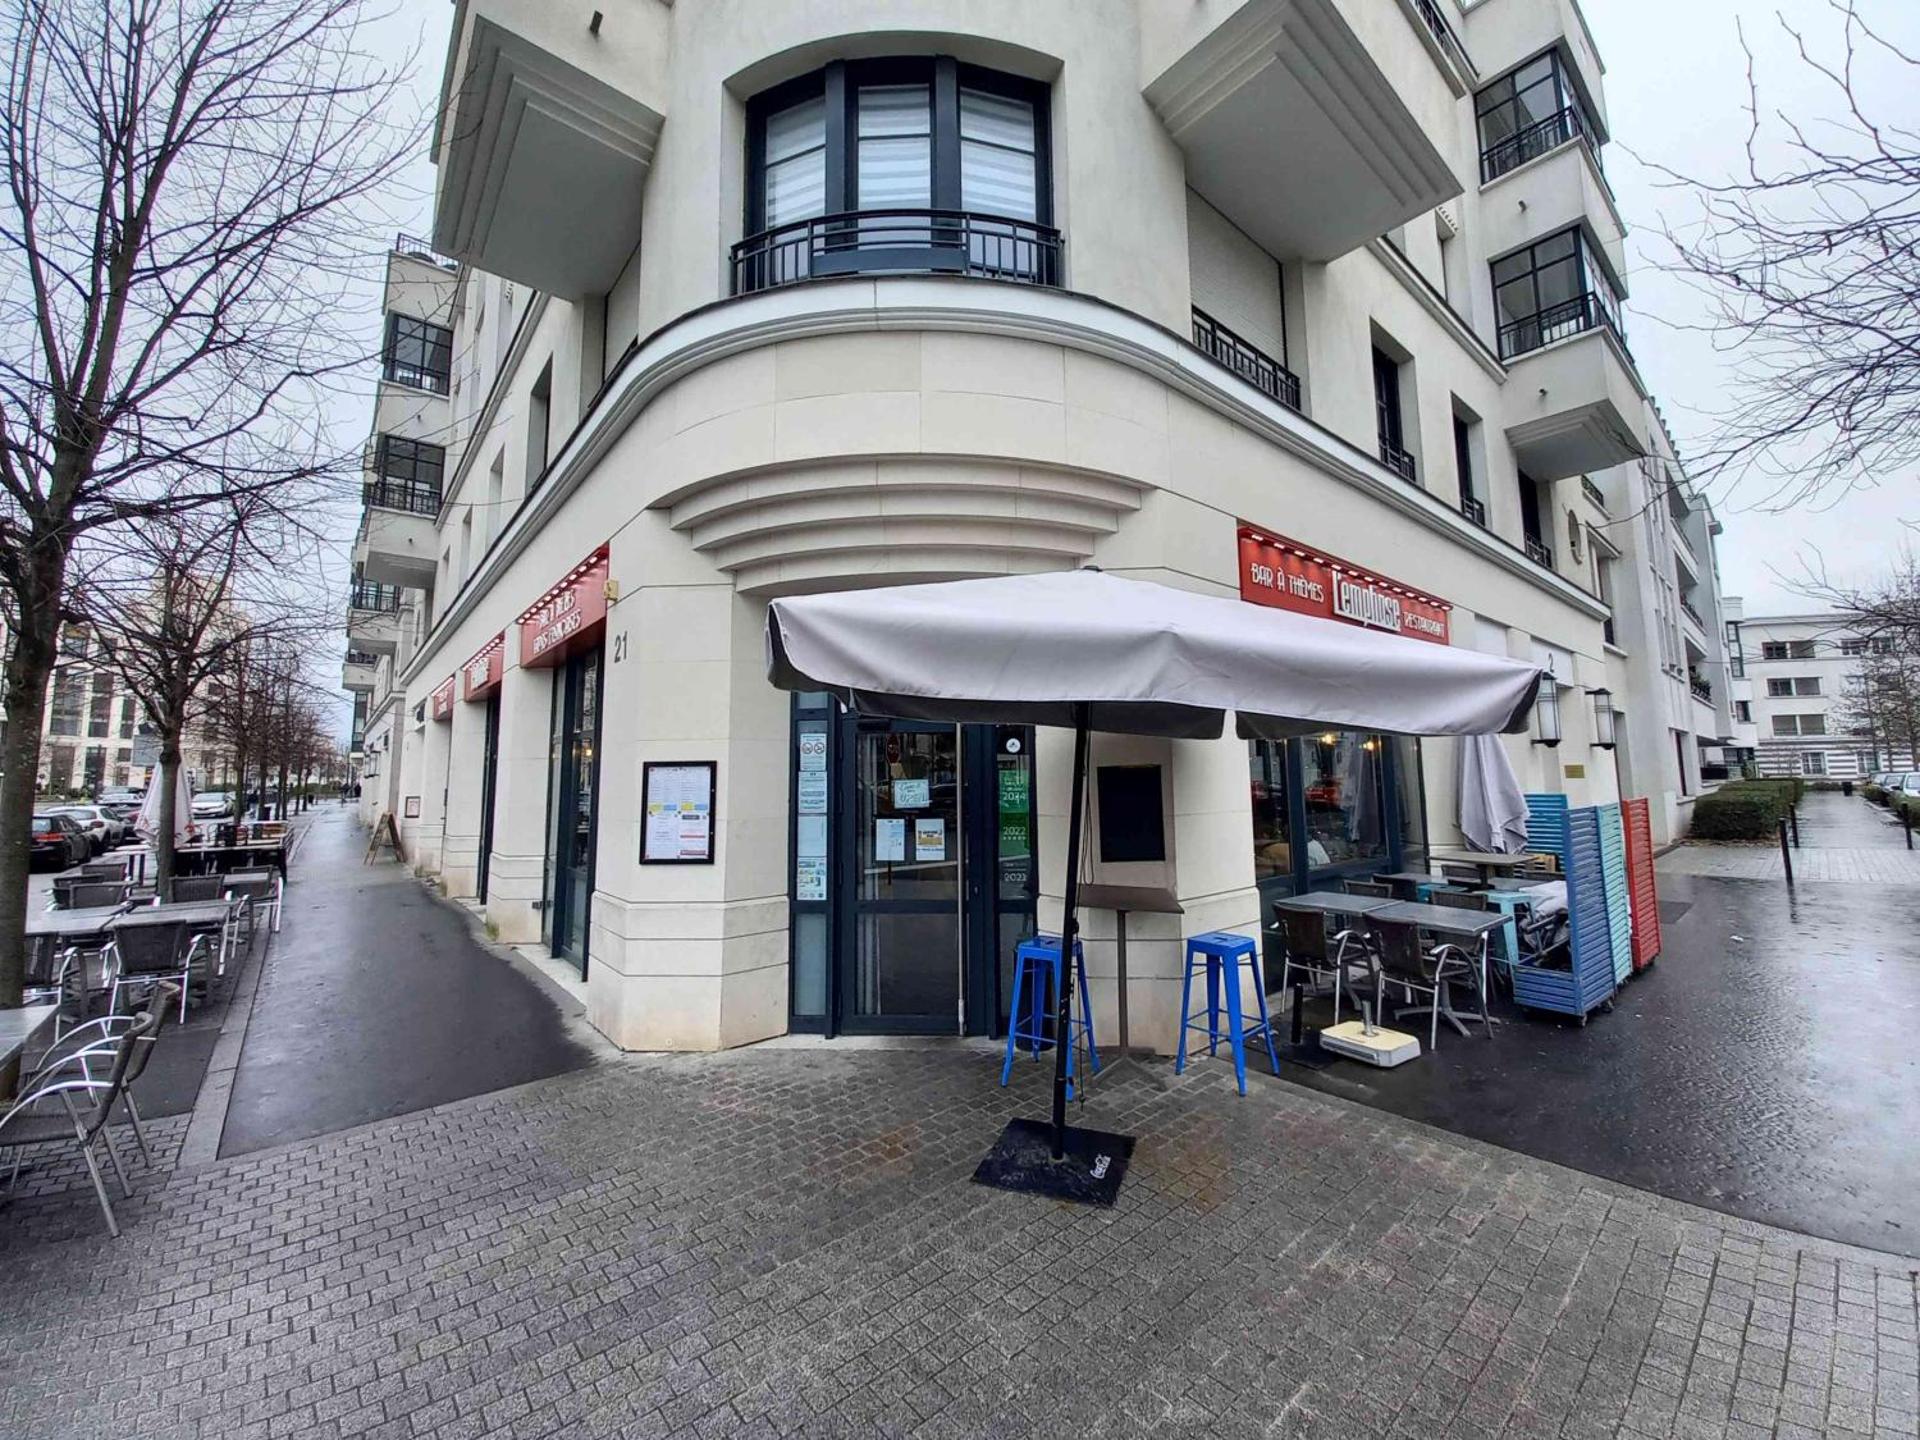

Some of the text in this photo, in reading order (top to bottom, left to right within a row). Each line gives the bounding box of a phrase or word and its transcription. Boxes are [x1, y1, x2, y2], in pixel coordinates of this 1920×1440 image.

[1250, 562, 1325, 603] BAR À THÈMES
[613, 630, 628, 664] 21
[1003, 826, 1026, 836] 2022
